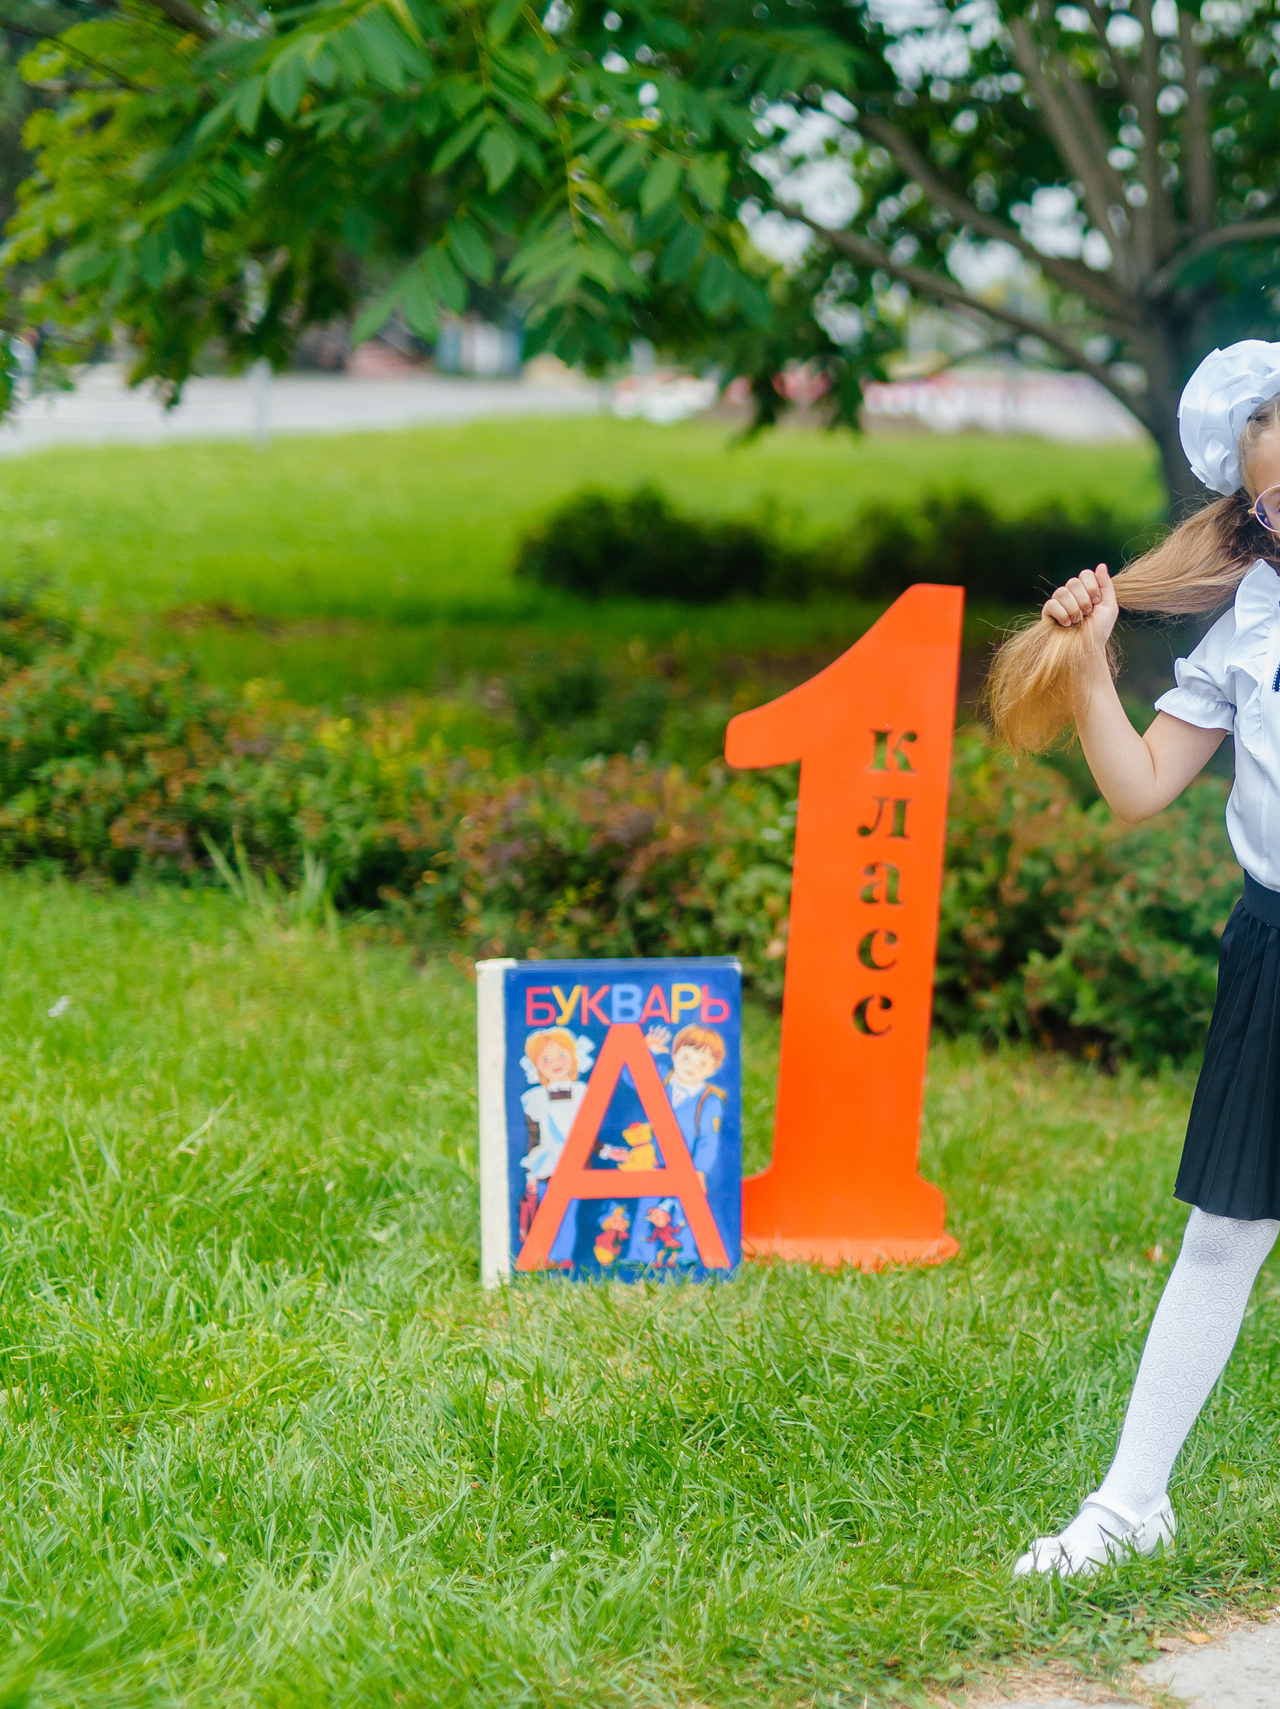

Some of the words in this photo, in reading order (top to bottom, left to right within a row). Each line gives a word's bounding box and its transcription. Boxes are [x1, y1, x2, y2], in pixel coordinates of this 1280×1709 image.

[525, 983, 730, 1027] БУКВАРЬ
[852, 729, 917, 1037] класс
[514, 1023, 732, 1272] А
